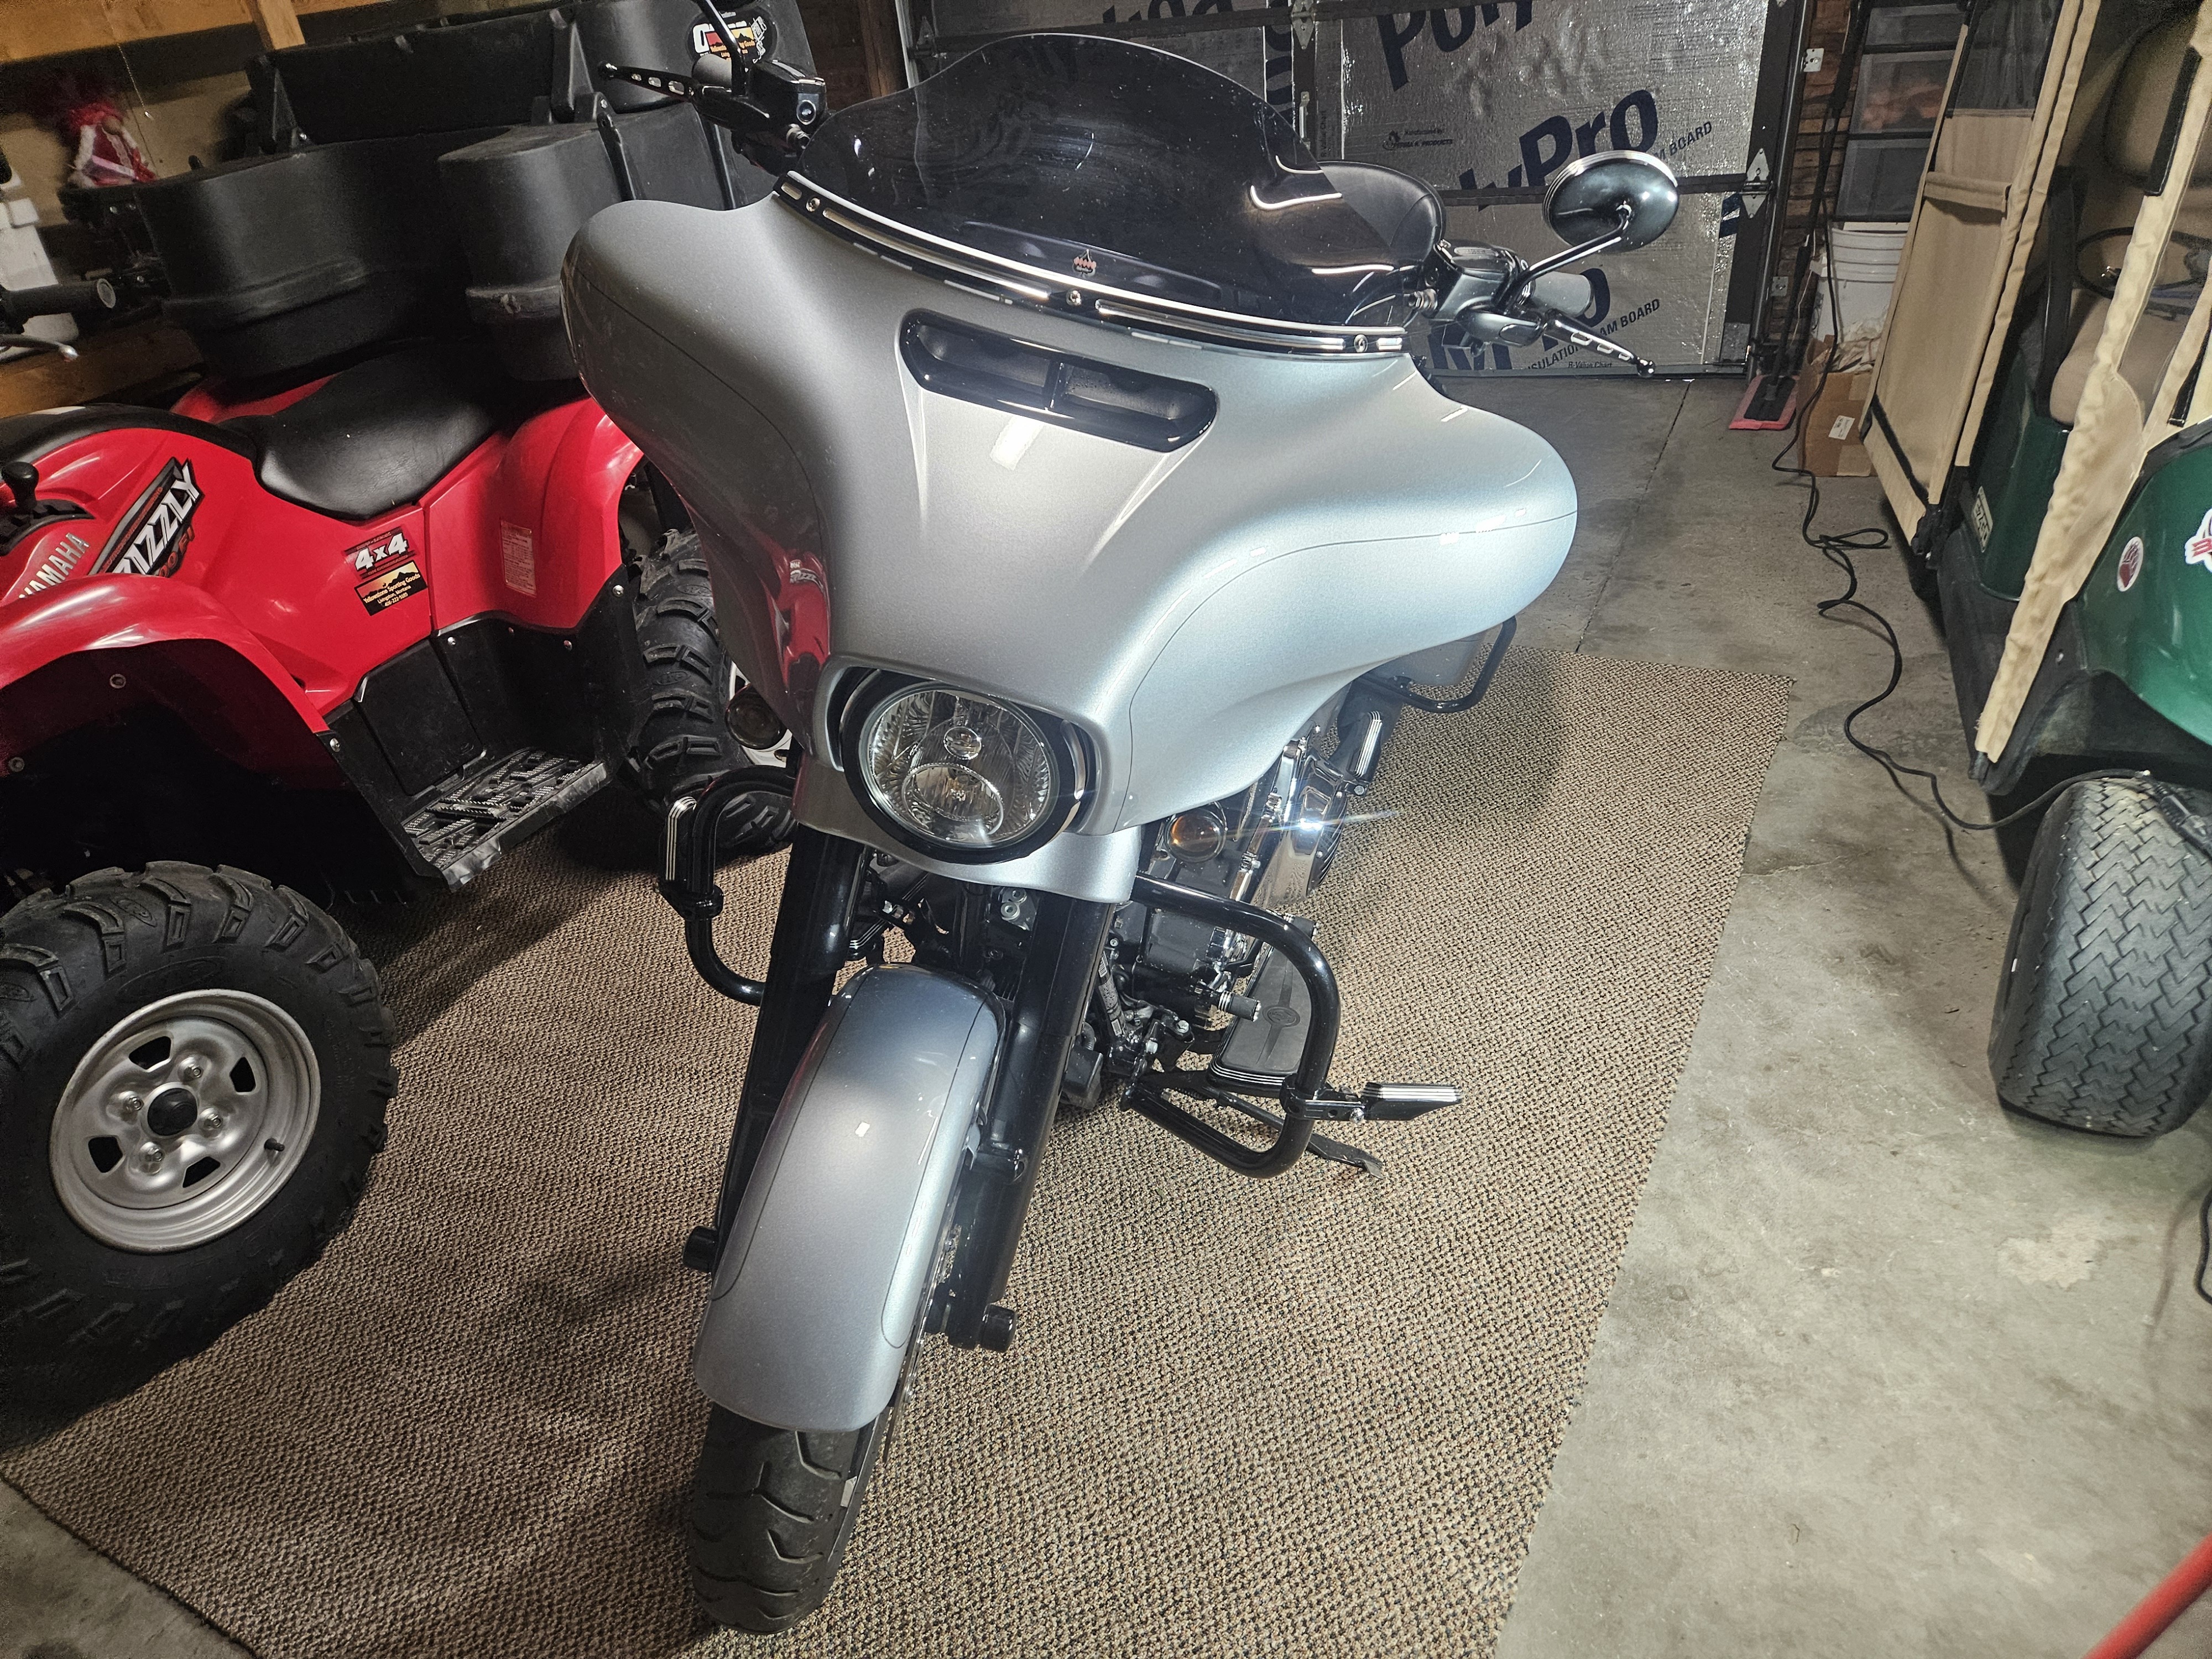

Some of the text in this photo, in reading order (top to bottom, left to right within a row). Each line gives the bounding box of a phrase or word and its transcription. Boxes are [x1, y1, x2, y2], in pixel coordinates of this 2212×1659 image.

[1670, 121, 1712, 155] BOARD
[1620, 299, 1660, 328] BOARD
[354, 533, 408, 570] 4x4
[363, 573, 421, 603] Yellowstone Sporting Goods
[395, 586, 411, 595] Montana
